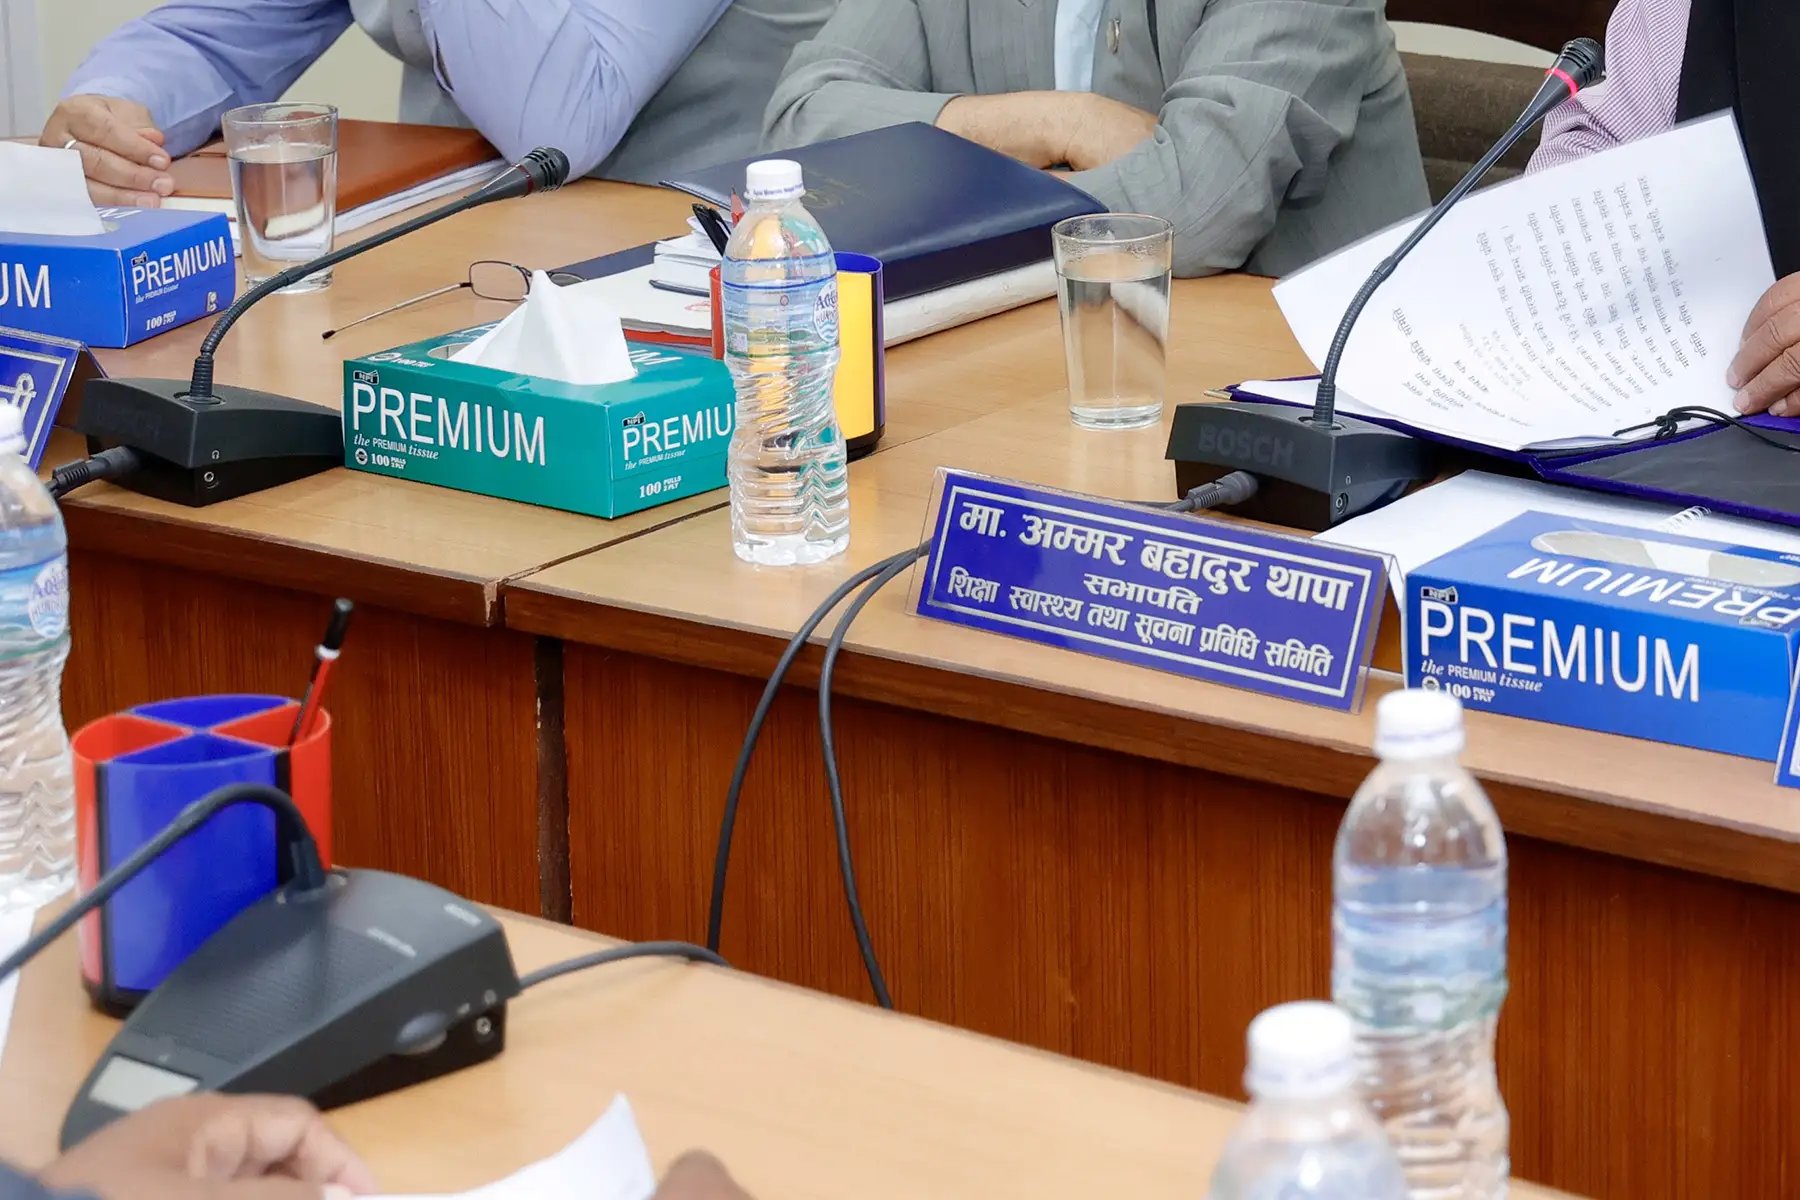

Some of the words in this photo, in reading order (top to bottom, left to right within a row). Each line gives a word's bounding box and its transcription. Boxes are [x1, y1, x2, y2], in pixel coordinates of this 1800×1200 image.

[131, 236, 228, 295] PREMIUM
[352, 382, 546, 466] PREMIUM
[353, 434, 370, 447] the
[372, 438, 407, 454] PREMIUM
[408, 444, 439, 460] tissue
[622, 401, 738, 461] PREMIU
[1199, 423, 1295, 470] BOSCH
[371, 452, 390, 467] 100
[639, 481, 662, 498] 100
[959, 501, 1007, 538] मा.
[1018, 513, 1134, 566] अम्मर
[1140, 538, 1259, 596] बहादुर
[1266, 564, 1354, 611] थापा
[1083, 572, 1203, 615] सभापति
[947, 566, 1001, 603] शिक्षा
[1008, 585, 1084, 622] स्वास्थ्य
[1087, 602, 1131, 632] तथा
[1199, 623, 1261, 661] प्रविधि
[1264, 638, 1334, 677] समिति
[1420, 599, 1699, 703] PREMIUM
[1420, 659, 1445, 675] the
[1447, 664, 1497, 684] PREMIUM
[1499, 673, 1543, 693] tissue
[1444, 682, 1472, 699] 100
